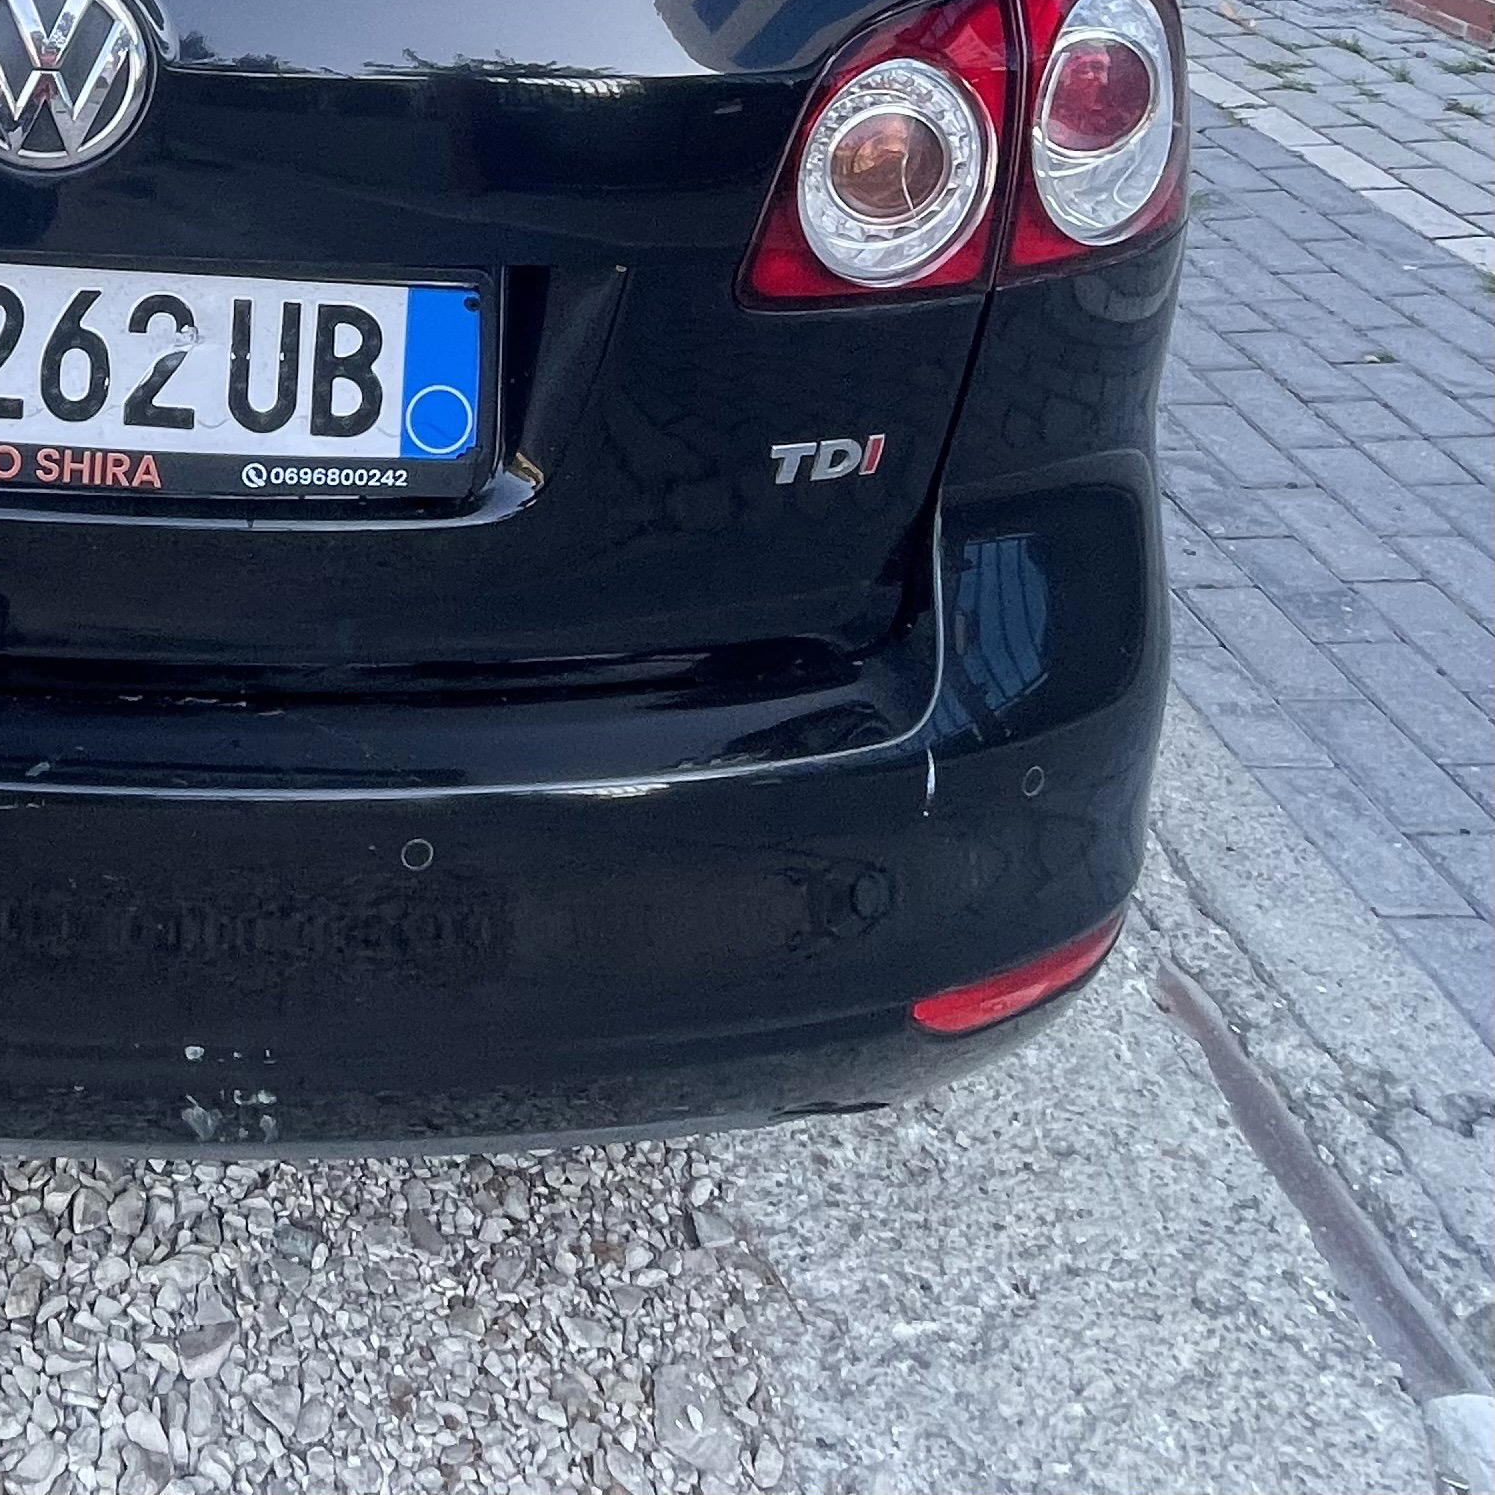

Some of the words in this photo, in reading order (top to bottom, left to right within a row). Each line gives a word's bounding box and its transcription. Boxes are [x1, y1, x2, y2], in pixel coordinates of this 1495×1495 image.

[227, 298, 384, 438] UB
[34, 447, 163, 489] SHIRA
[269, 466, 409, 487] 0696800242
[770, 433, 886, 485] TDI
